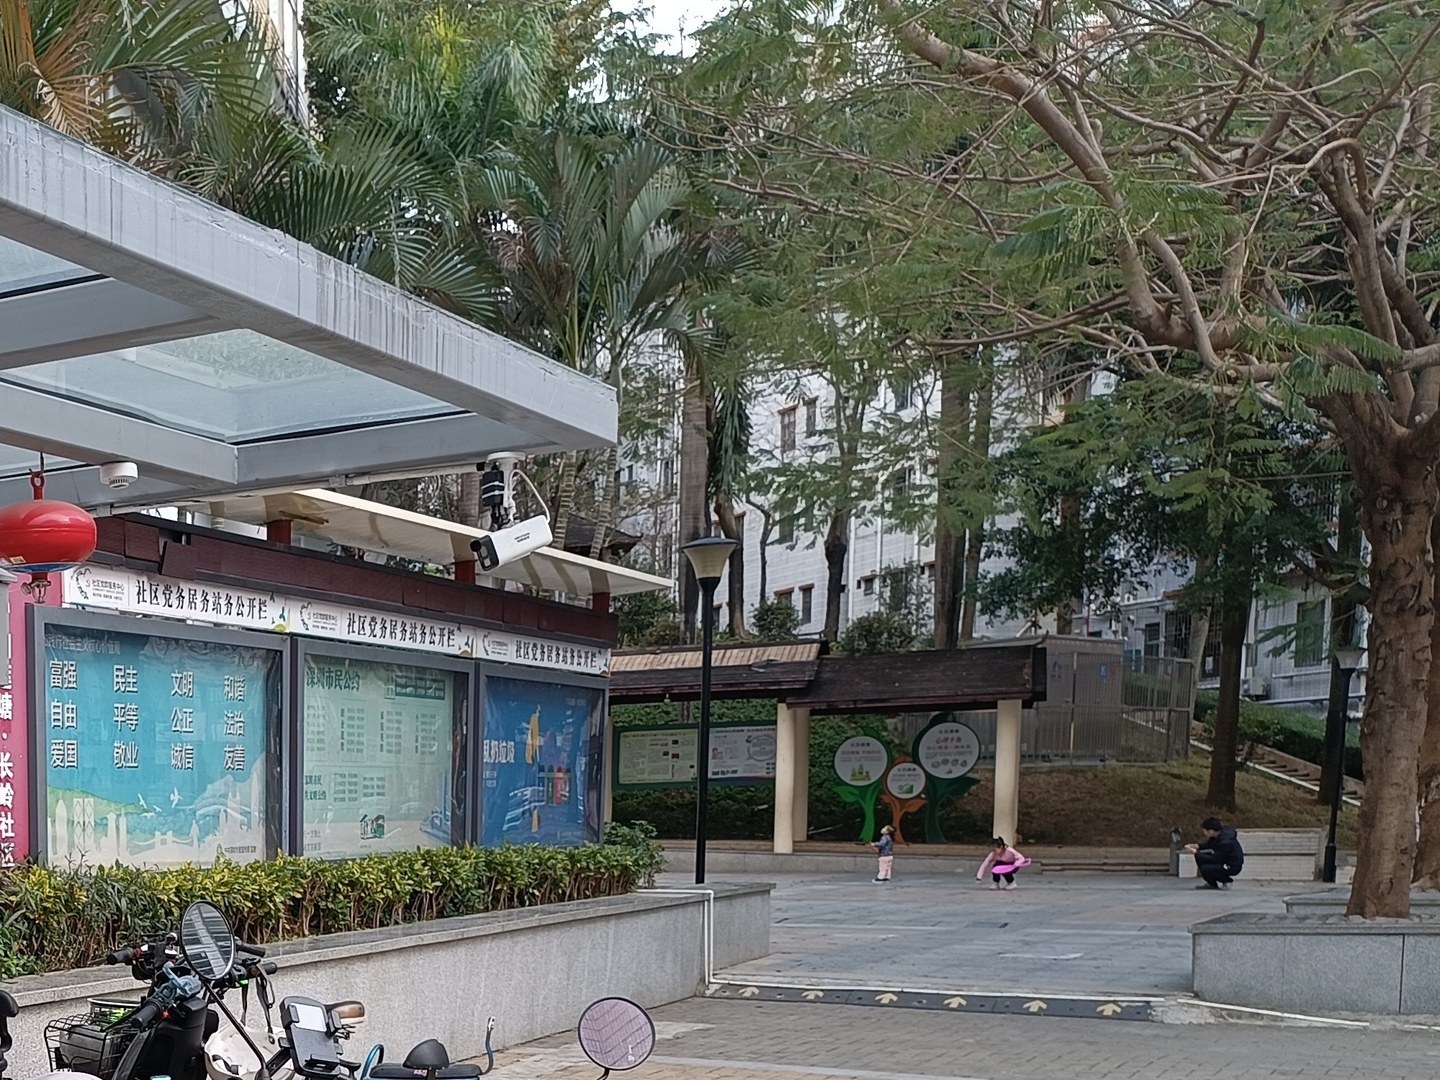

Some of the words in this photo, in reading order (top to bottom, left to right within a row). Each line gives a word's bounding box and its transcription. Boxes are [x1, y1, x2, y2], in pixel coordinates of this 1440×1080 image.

[135, 579, 268, 620] 社区党务居务站务公开栏
[347, 611, 456, 648] 社区党务居务站务公开栏
[515, 639, 597, 669] 社区党务居务站务公开栏
[49, 658, 78, 691] 富强
[113, 664, 139, 694] 民主
[171, 669, 195, 698] 文明
[224, 674, 247, 702] 和谐
[306, 666, 361, 692] 深圳市民公约
[50, 699, 78, 730] 自由
[113, 702, 139, 732] 平等
[171, 707, 194, 734] 公正
[224, 710, 245, 736] 法治
[50, 739, 78, 769] 爱国
[113, 740, 139, 769] 敬业
[171, 742, 195, 771] 诚信
[223, 744, 246, 772] 友善
